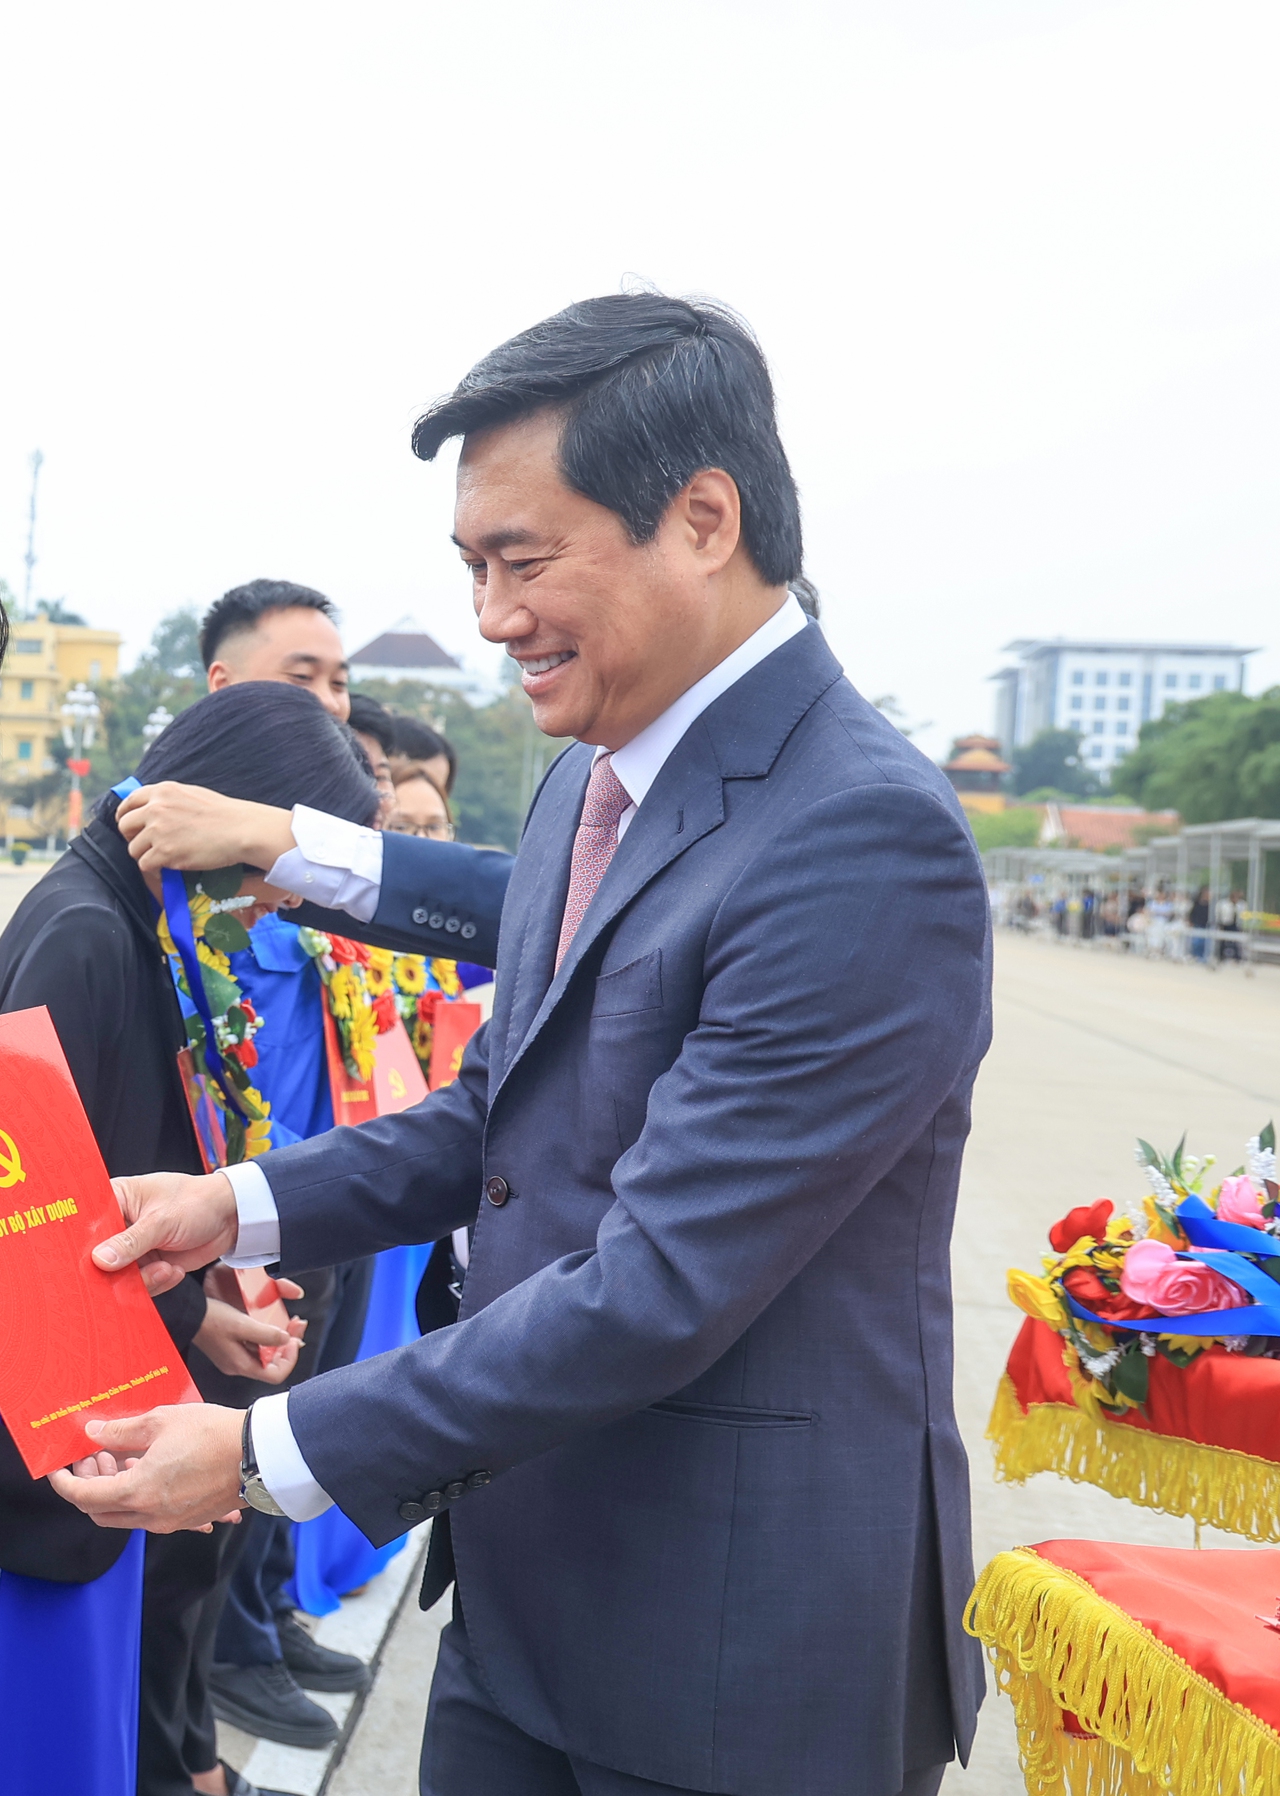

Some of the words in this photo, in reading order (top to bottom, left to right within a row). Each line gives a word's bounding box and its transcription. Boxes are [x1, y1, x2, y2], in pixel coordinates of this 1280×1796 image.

[7, 1211, 26, 1234] BỘ
[23, 1206, 46, 1228] XÂY
[45, 1198, 78, 1222] DỰNG
